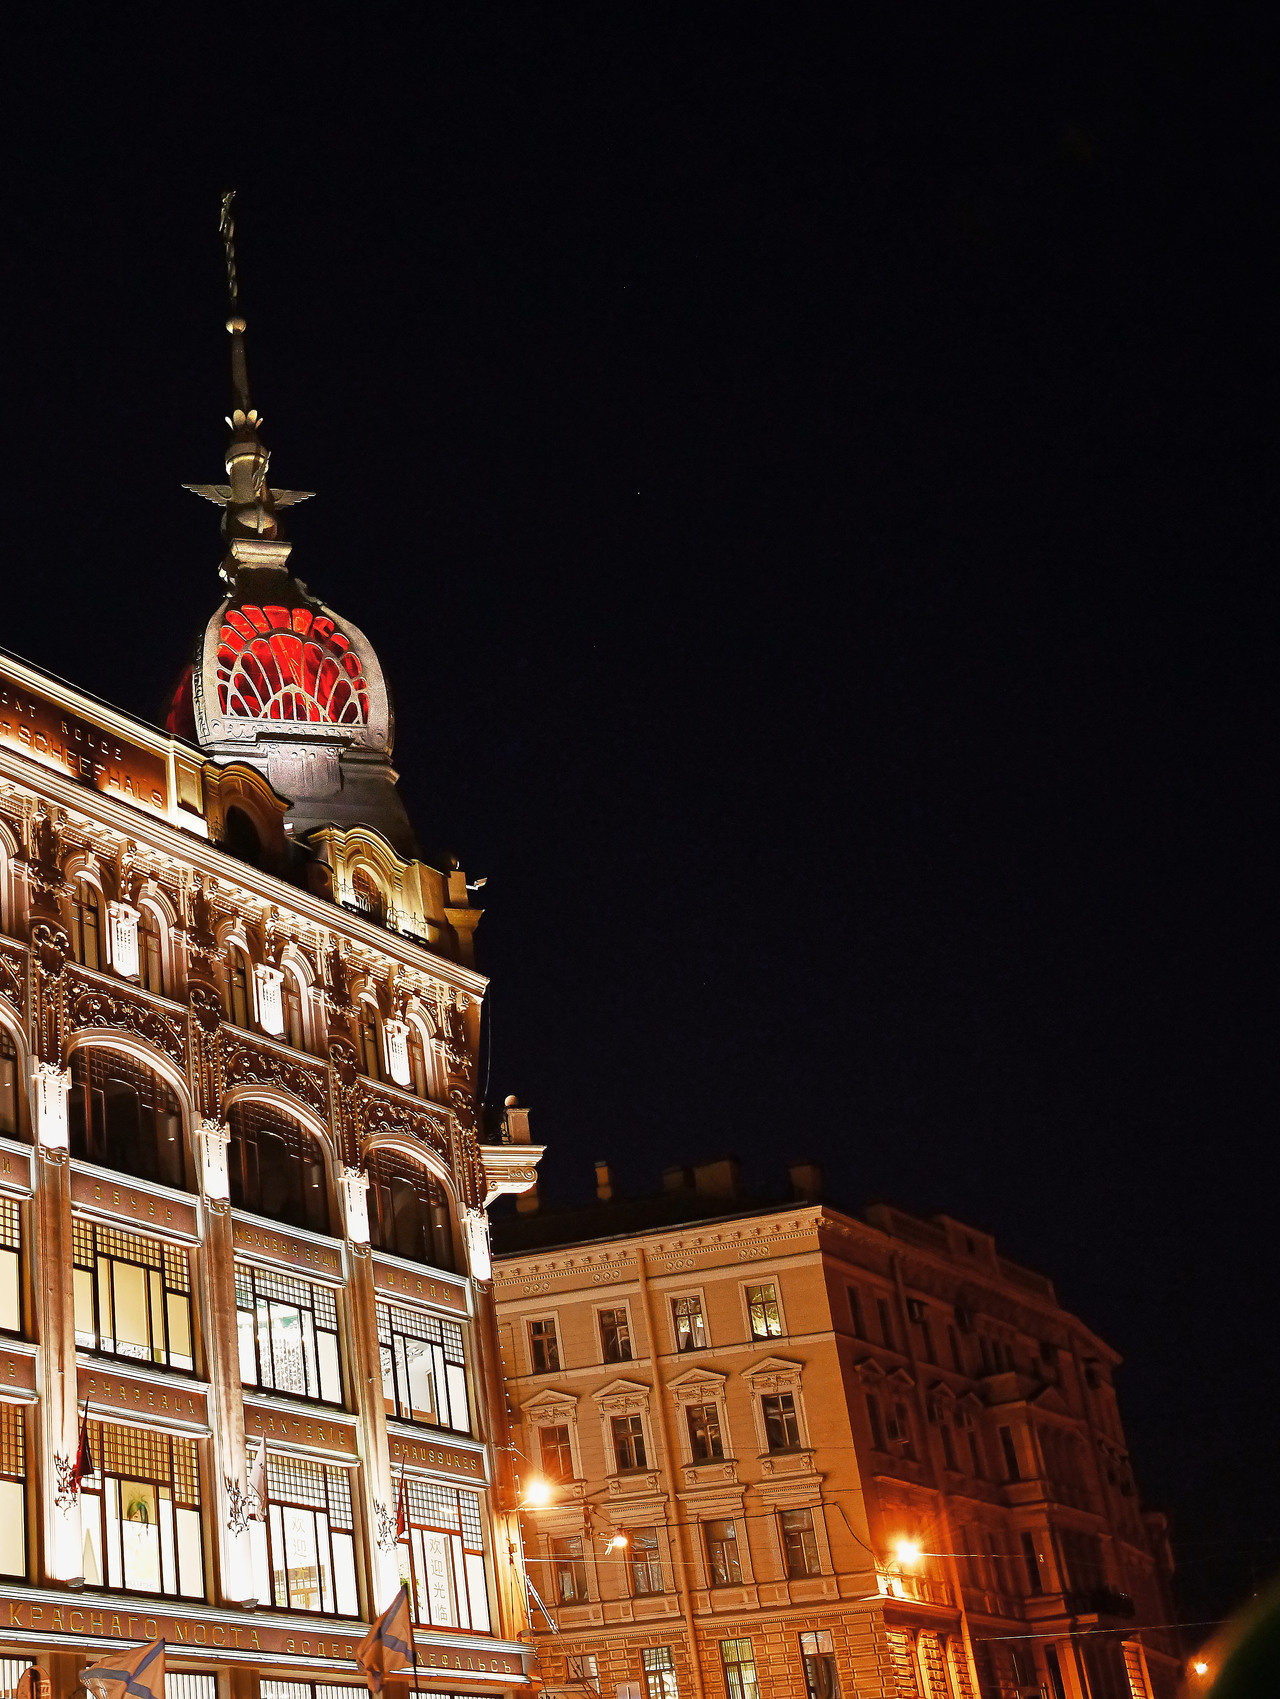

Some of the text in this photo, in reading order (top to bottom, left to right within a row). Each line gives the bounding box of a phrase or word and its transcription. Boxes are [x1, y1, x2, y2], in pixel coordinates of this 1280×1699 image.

[88, 1378, 195, 1415] CHAPEAUX
[392, 1441, 478, 1472] CHAUSSURES
[428, 1536, 449, 1623] 欢迎光临
[9, 1602, 159, 1640] КРАСНАГО
[174, 1619, 262, 1650] МОСТА
[285, 1638, 354, 1659] ЭСДЕР
[416, 1650, 513, 1674] ХЕФАЛЬСЪ
